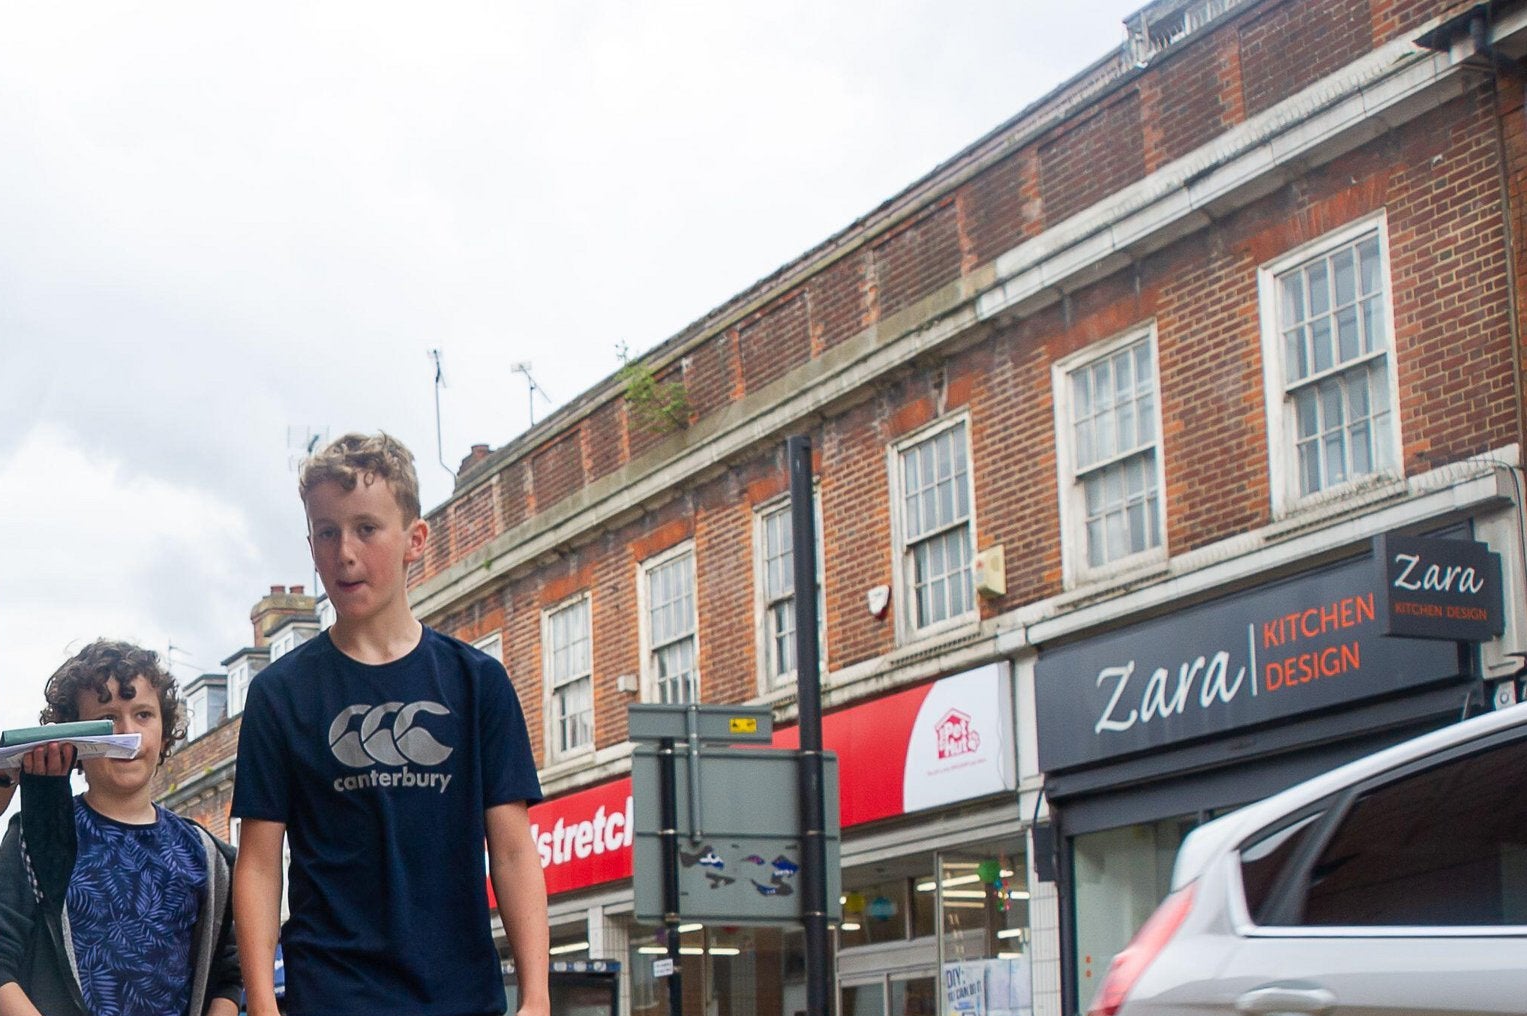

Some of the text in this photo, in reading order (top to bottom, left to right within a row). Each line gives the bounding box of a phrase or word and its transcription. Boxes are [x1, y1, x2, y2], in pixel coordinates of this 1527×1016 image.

[1394, 553, 1484, 594] Zara
[1263, 592, 1375, 649] KITCHEN
[1394, 602, 1488, 620] KITCHEN DESIGN
[1265, 641, 1361, 692] DESIGN
[1094, 650, 1246, 735] Zara
[333, 766, 452, 793] canterbury
